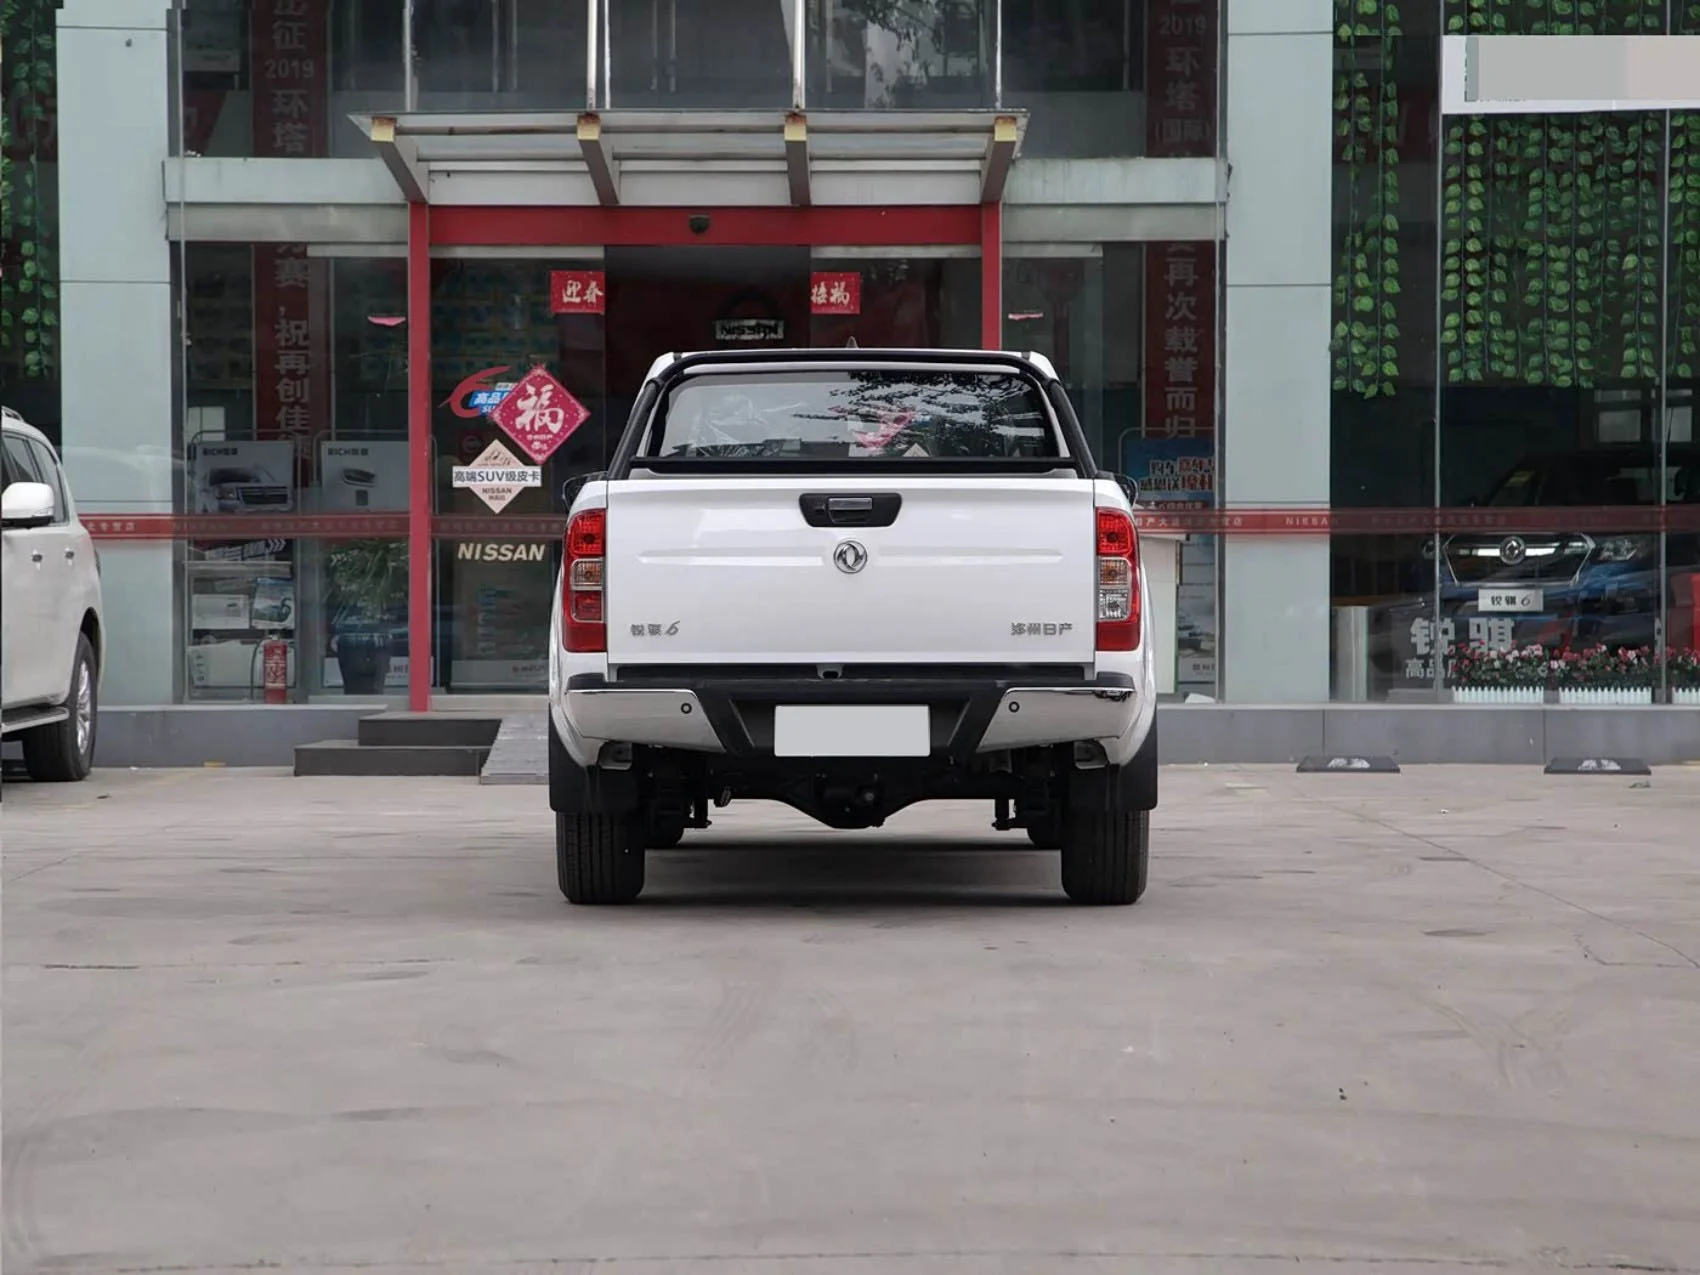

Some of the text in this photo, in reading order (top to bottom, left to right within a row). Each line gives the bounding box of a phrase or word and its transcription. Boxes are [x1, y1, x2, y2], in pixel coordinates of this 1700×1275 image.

[561, 279, 604, 304] 迎春
[473, 391, 509, 405] 高品
[513, 383, 565, 434] 福
[453, 469, 541, 484] 高端SUV级皮卡
[481, 486, 513, 495] NISSAN
[457, 542, 546, 562] NISSAN
[1010, 621, 1074, 636] 郑州日产
